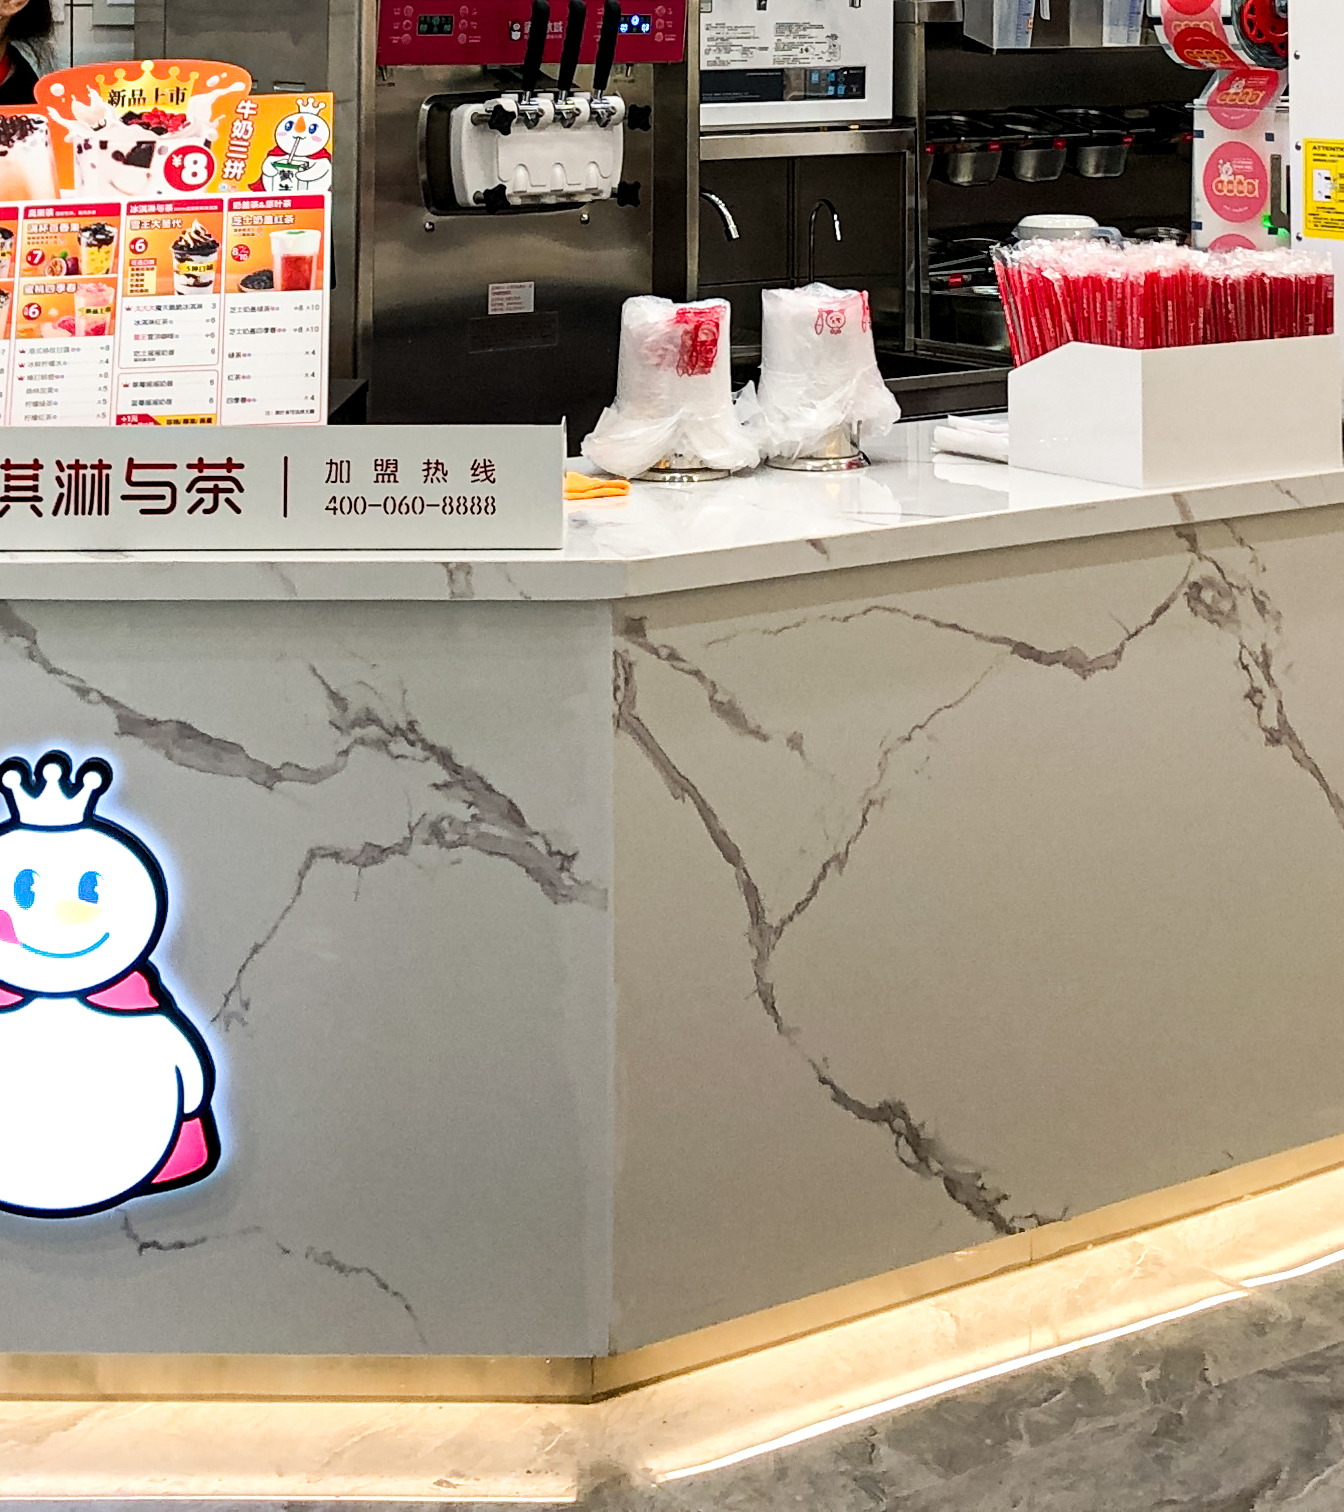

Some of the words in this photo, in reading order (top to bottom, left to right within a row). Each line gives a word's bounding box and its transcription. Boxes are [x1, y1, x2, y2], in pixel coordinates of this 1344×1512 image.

[107, 86, 188, 109] 新品上市
[222, 98, 259, 182] 牛奶三拼
[323, 455, 498, 486] 加盟热线
[322, 493, 497, 518] 400-060-8888
